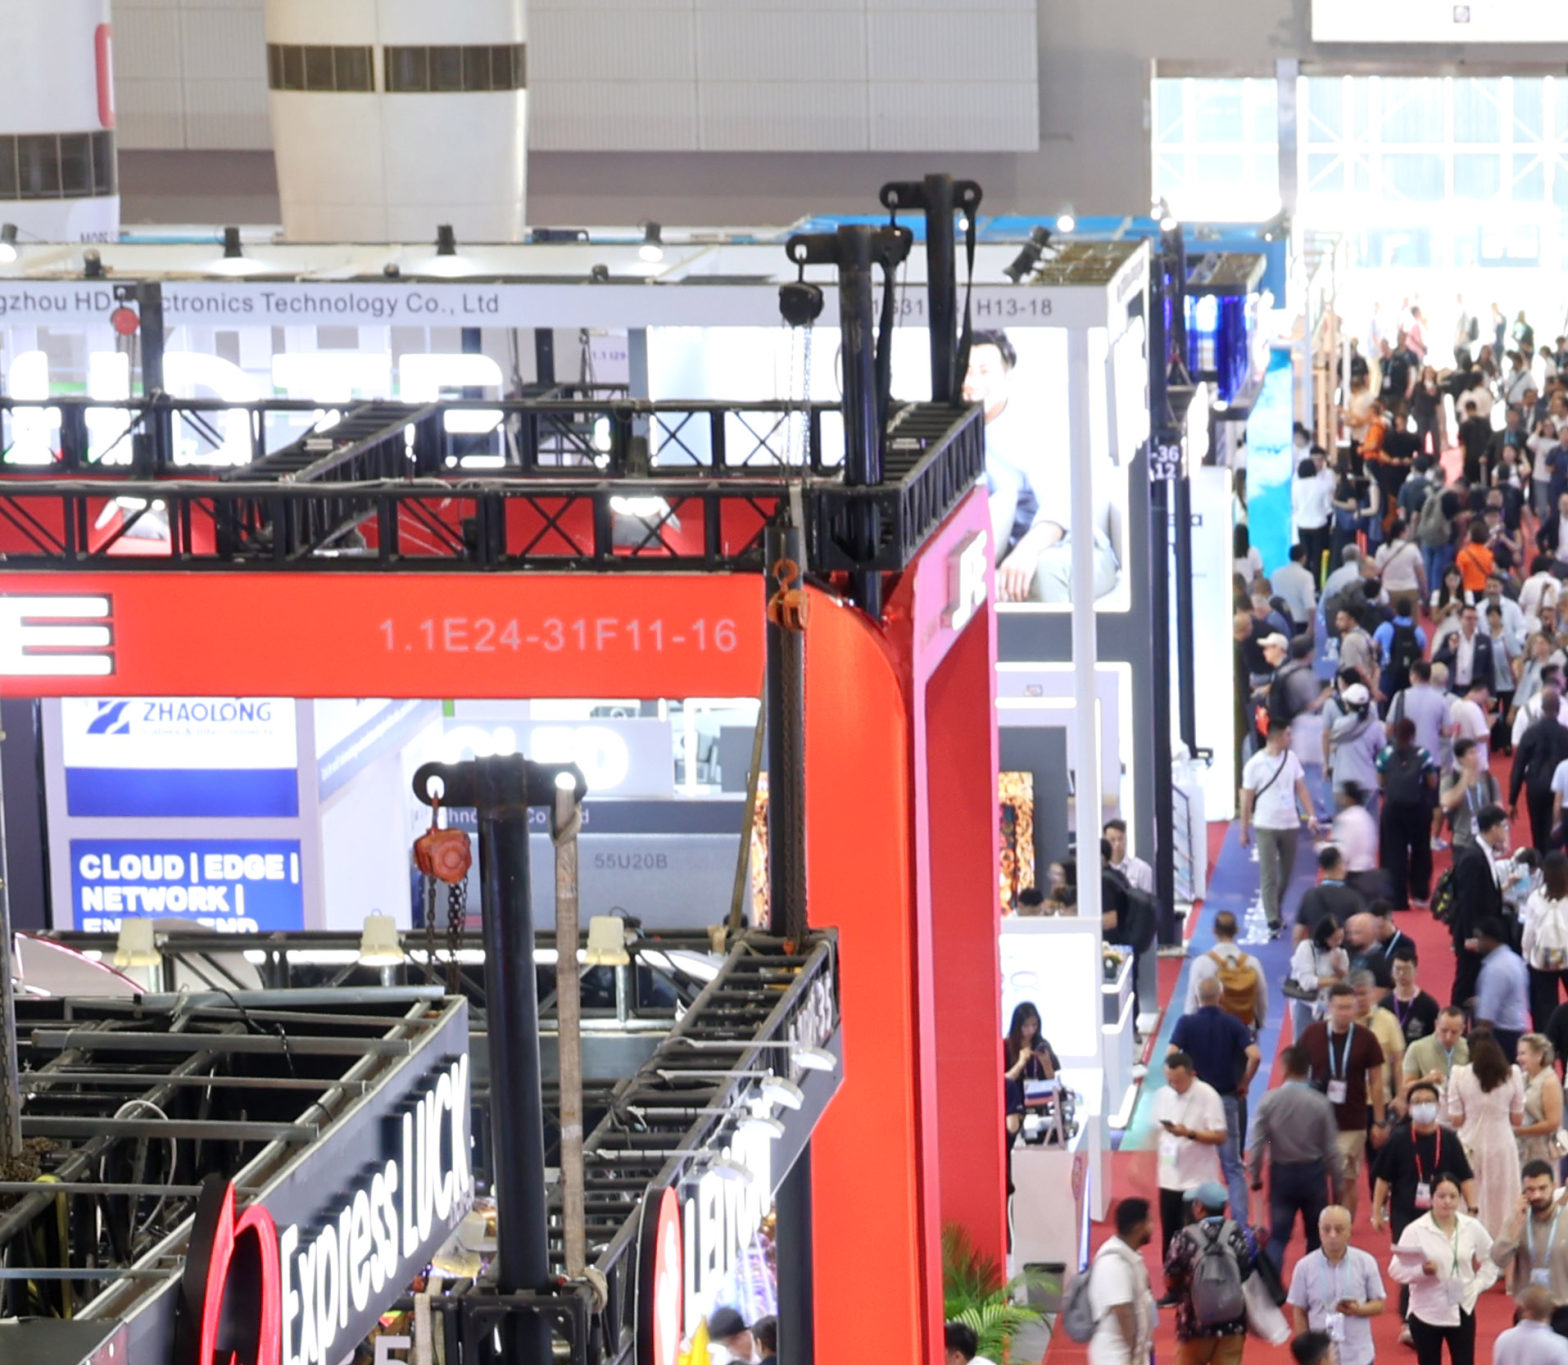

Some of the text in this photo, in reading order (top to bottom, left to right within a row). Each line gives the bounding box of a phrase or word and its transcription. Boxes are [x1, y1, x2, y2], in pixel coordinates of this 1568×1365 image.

[261, 292, 398, 317] Technology
[463, 292, 499, 313] Ltd
[380, 618, 737, 651] 1.1E24-31F11-16
[143, 701, 272, 722] ZHAOLONG
[79, 853, 285, 880] CLOUD EDGE
[81, 885, 230, 912] NETWORK
[403, 1052, 470, 1260] LUCK
